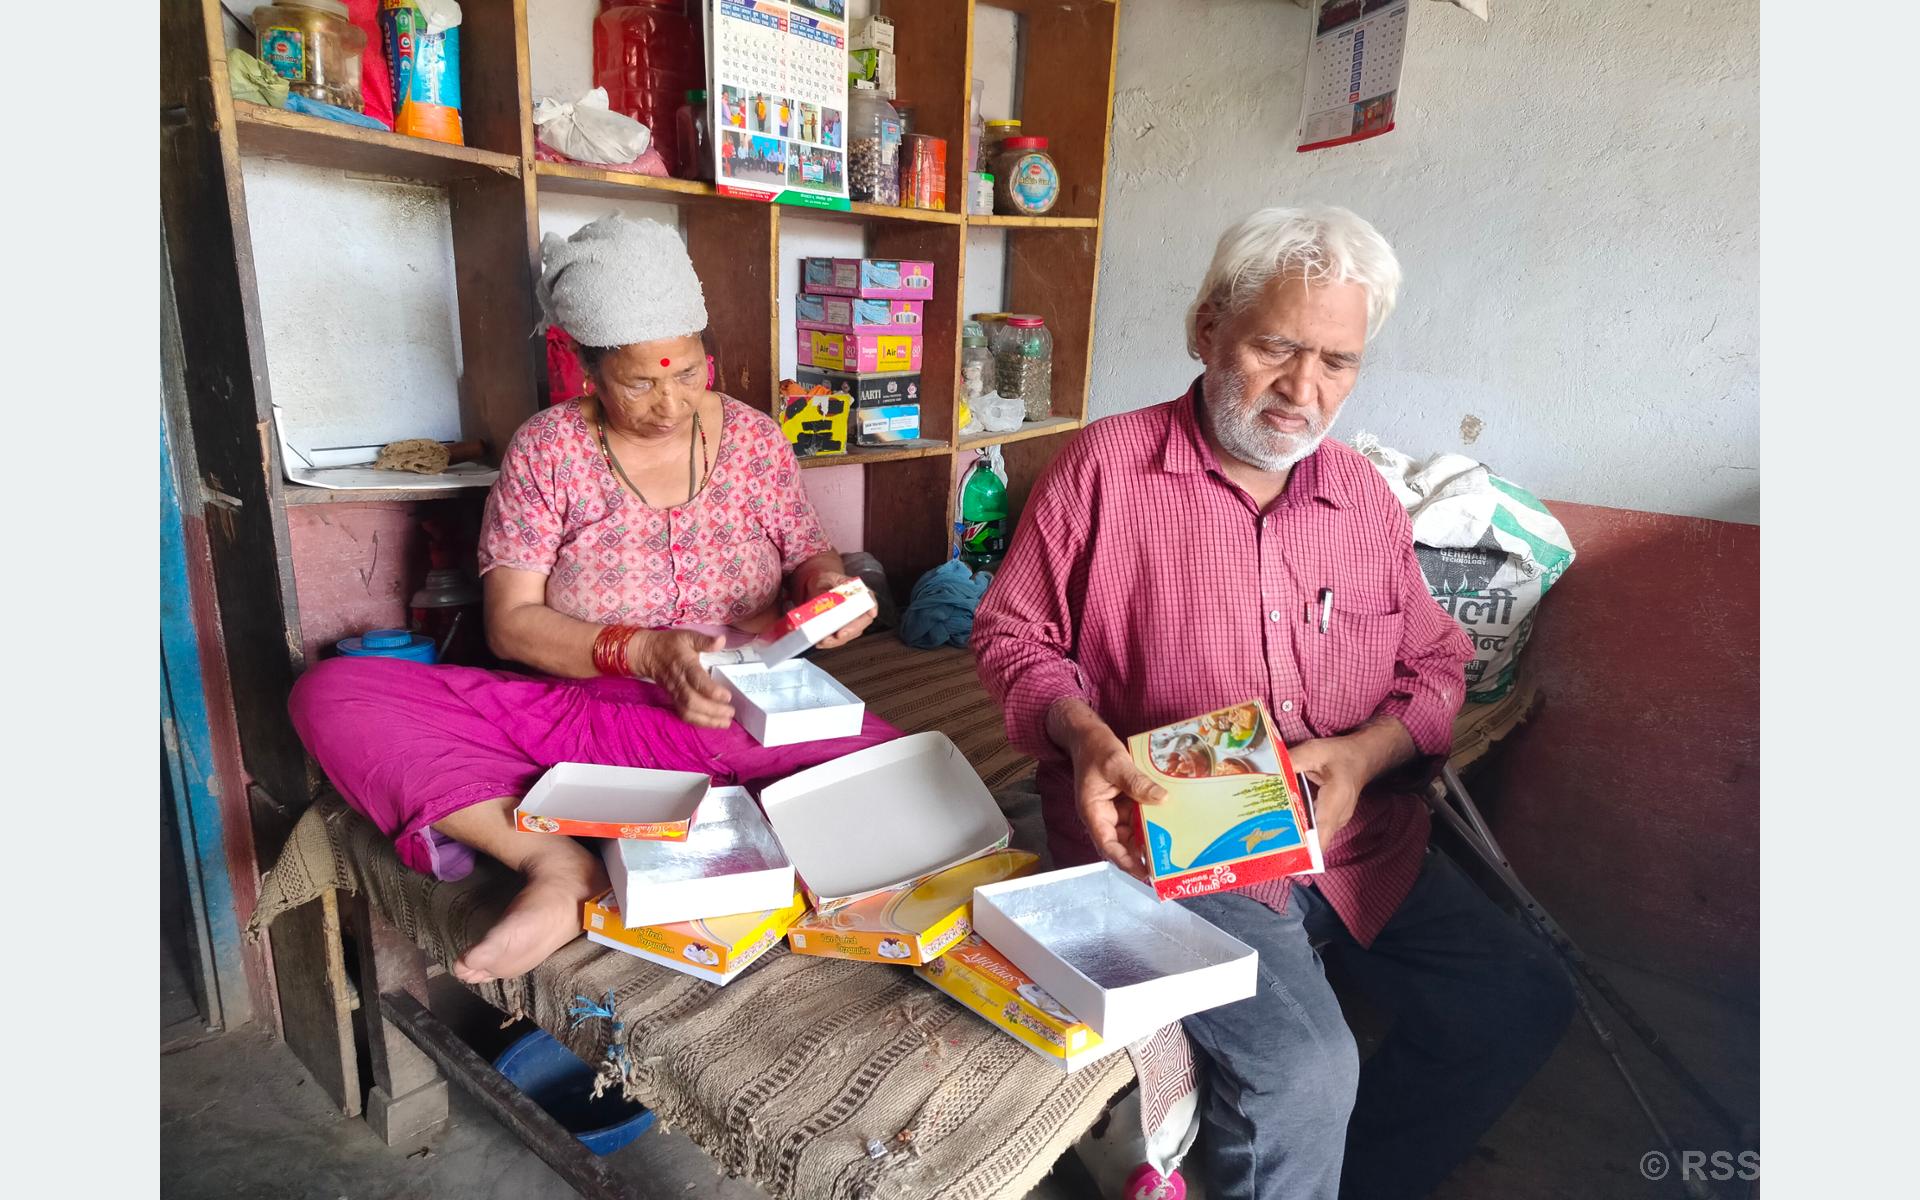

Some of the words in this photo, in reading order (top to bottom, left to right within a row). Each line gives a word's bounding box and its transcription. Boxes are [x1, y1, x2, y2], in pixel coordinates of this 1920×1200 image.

[887, 348, 896, 356] Air
[861, 389, 881, 400] AARTI
[1441, 557, 1487, 566] TECHNOLOGY
